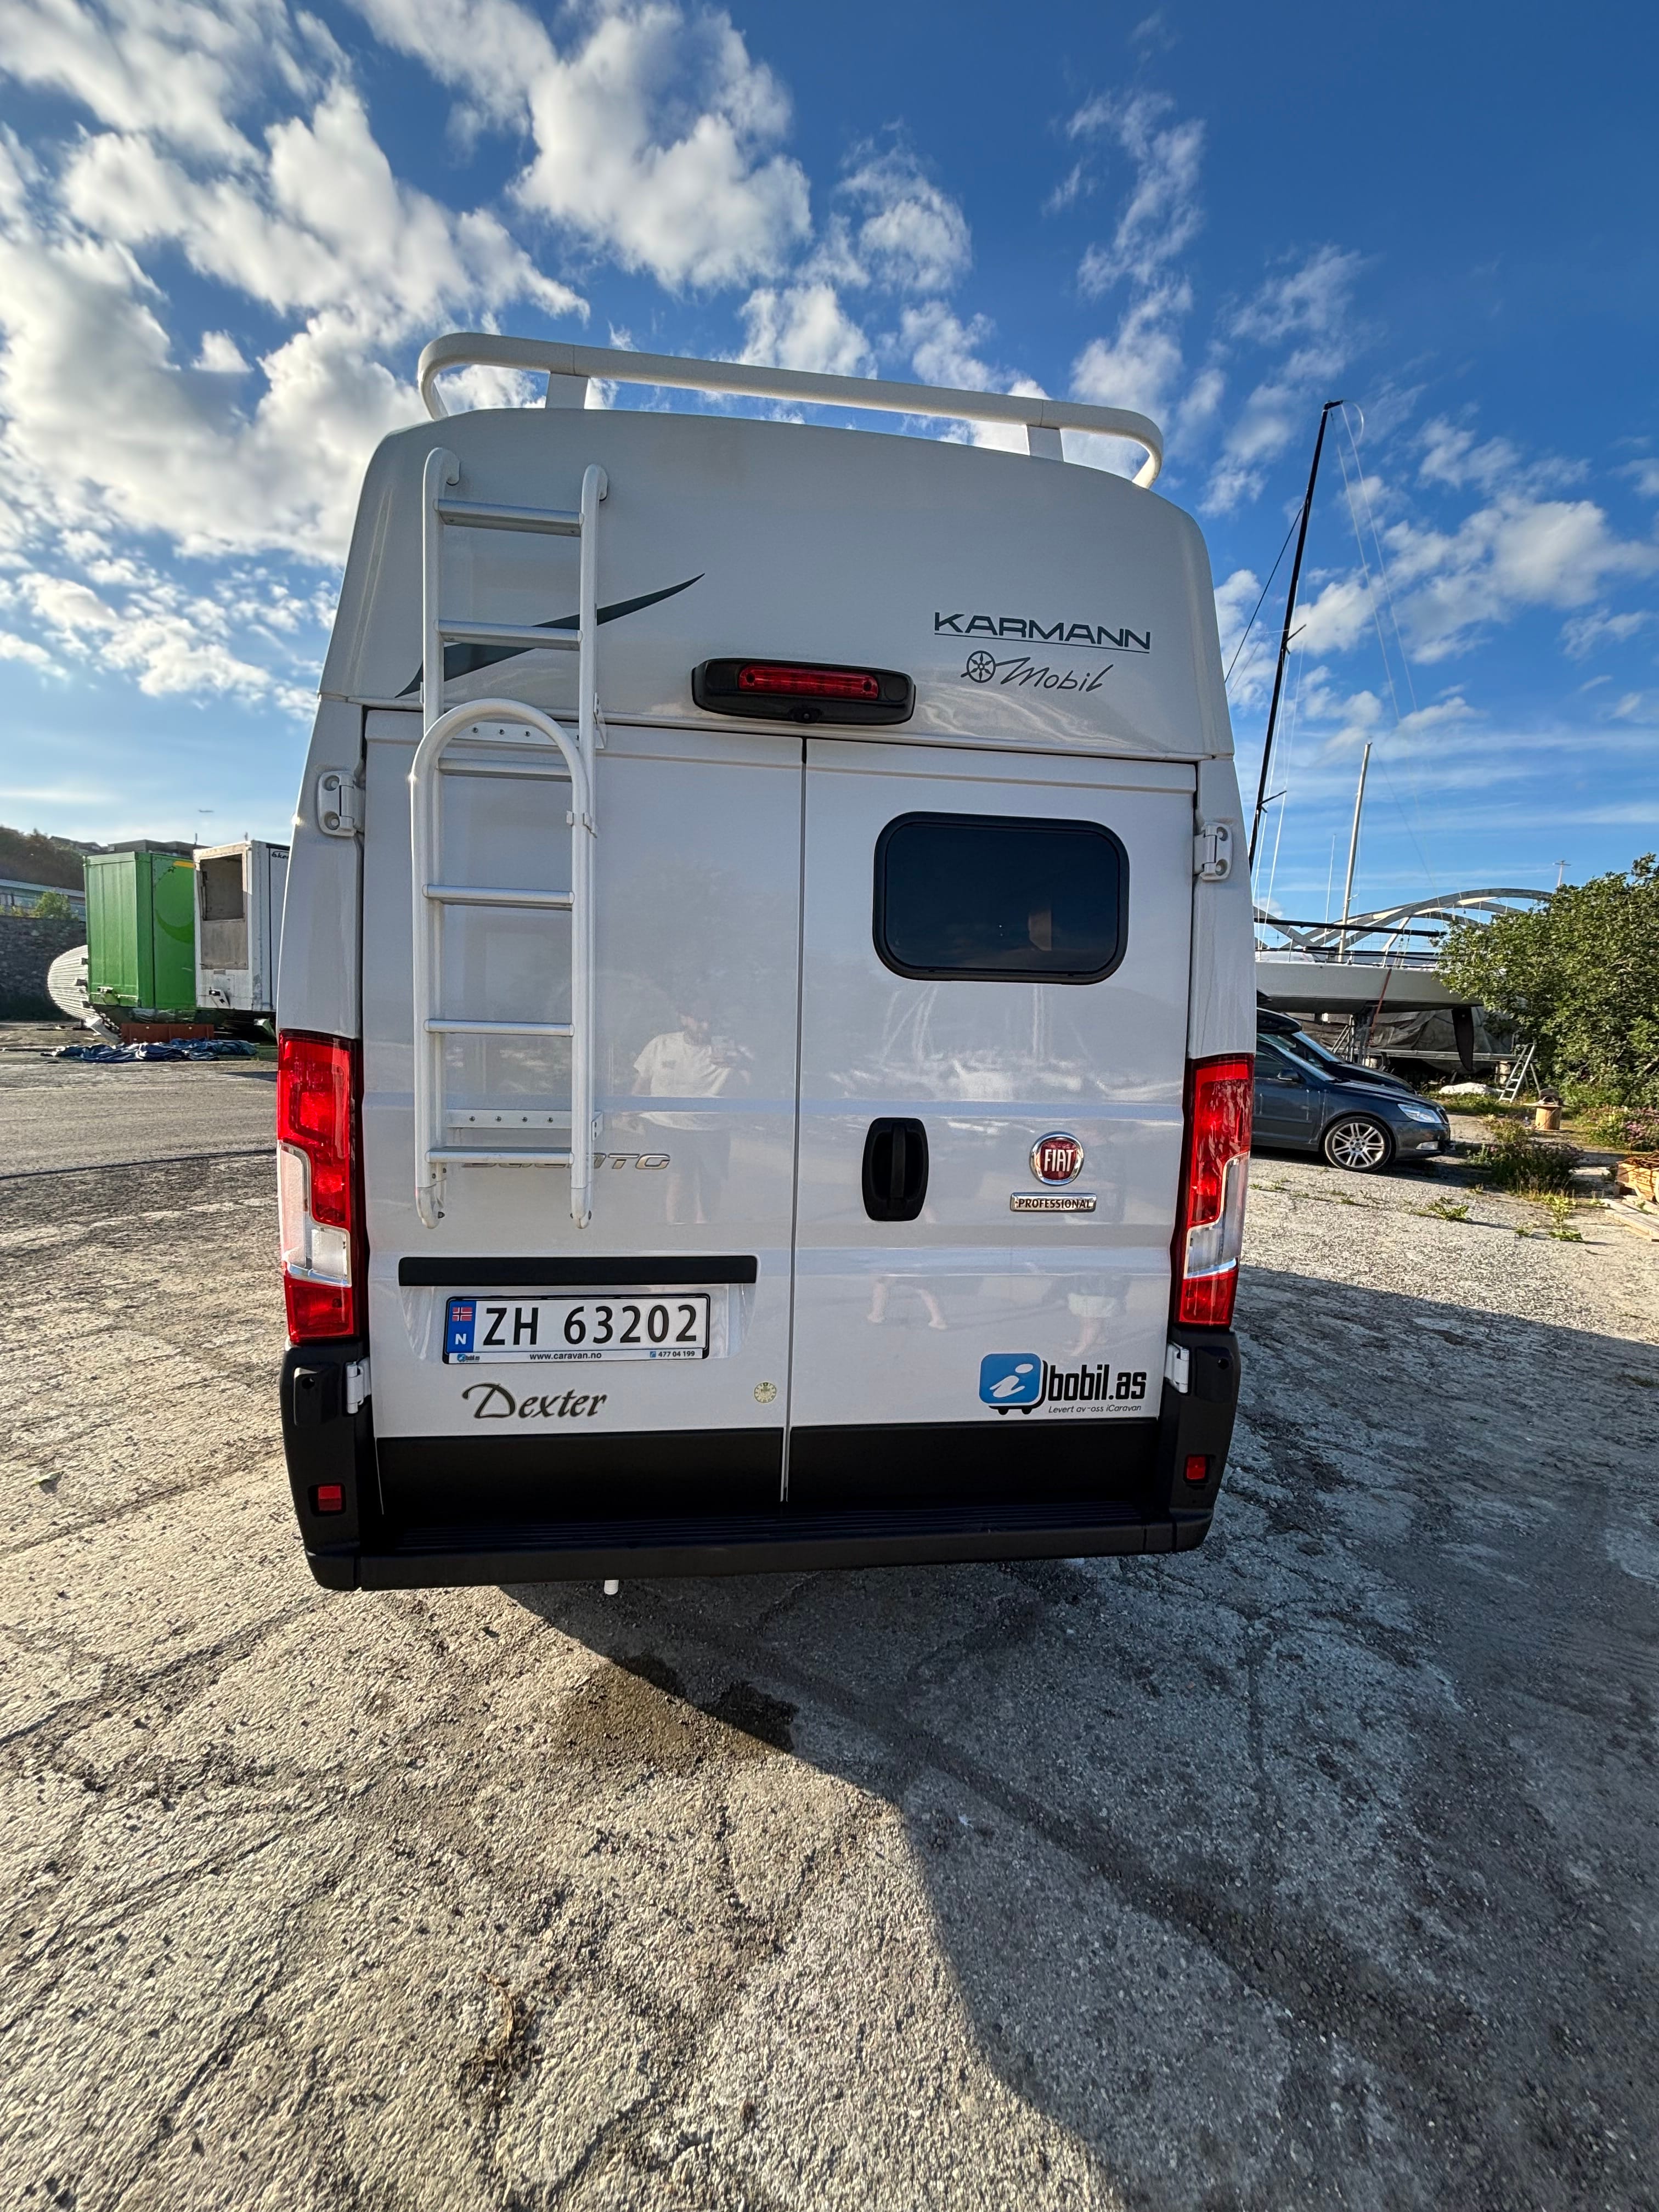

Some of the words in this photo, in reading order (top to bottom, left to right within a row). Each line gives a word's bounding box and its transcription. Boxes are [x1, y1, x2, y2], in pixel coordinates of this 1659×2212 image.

[935, 612, 1150, 650] KARMANN
[995, 657, 1114, 692] Mobil
[1044, 1149, 1074, 1172] FIAT
[1018, 1199, 1091, 1209] PROFESSIONAL
[455, 1334, 466, 1345] N
[483, 1307, 539, 1346] ZH
[563, 1305, 697, 1345] 63202
[529, 1352, 602, 1360] www.caravan.no
[1048, 1364, 1147, 1401] bobil.as
[462, 1383, 607, 1419] Dexter
